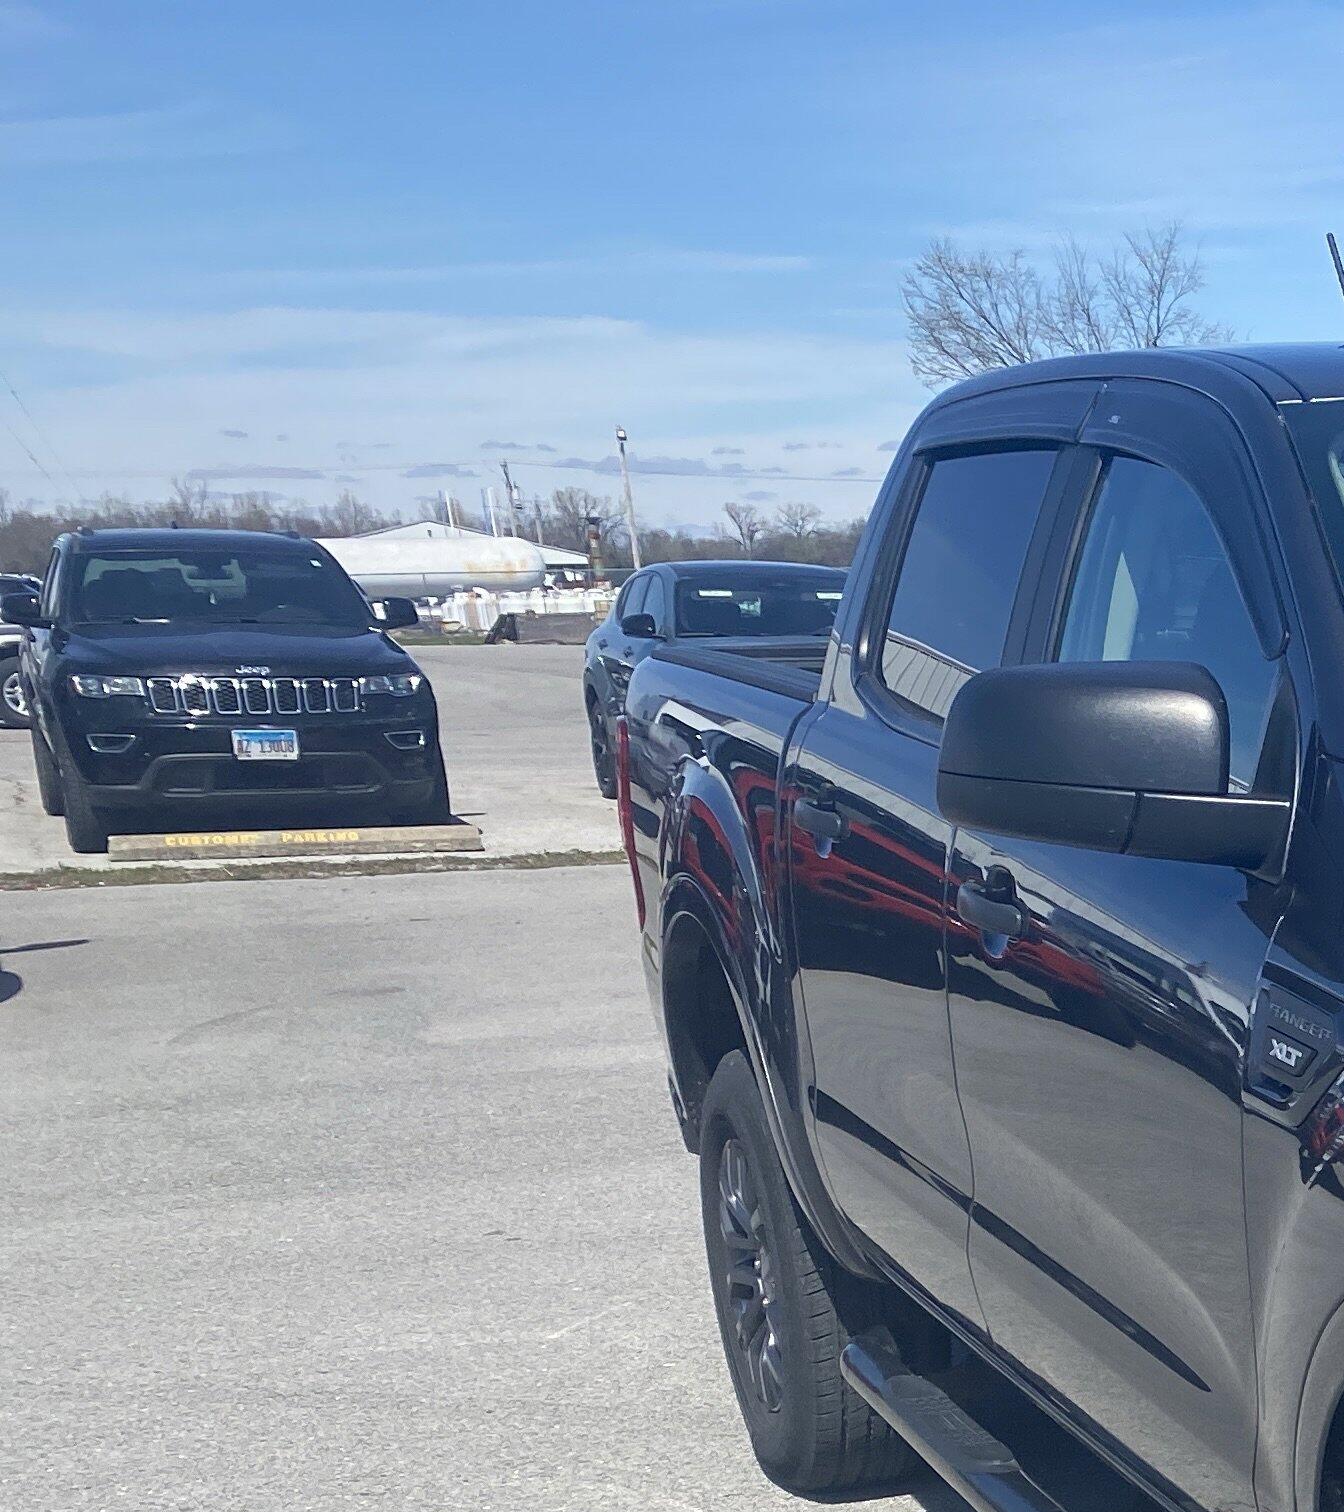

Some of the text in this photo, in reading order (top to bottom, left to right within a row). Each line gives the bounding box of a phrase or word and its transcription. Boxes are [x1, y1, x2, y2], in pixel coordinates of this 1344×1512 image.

[235, 664, 270, 676] Jeep
[281, 831, 359, 843] PARKING
[1270, 1003, 1333, 1040] RANGER
[1269, 1038, 1303, 1067] XLT
